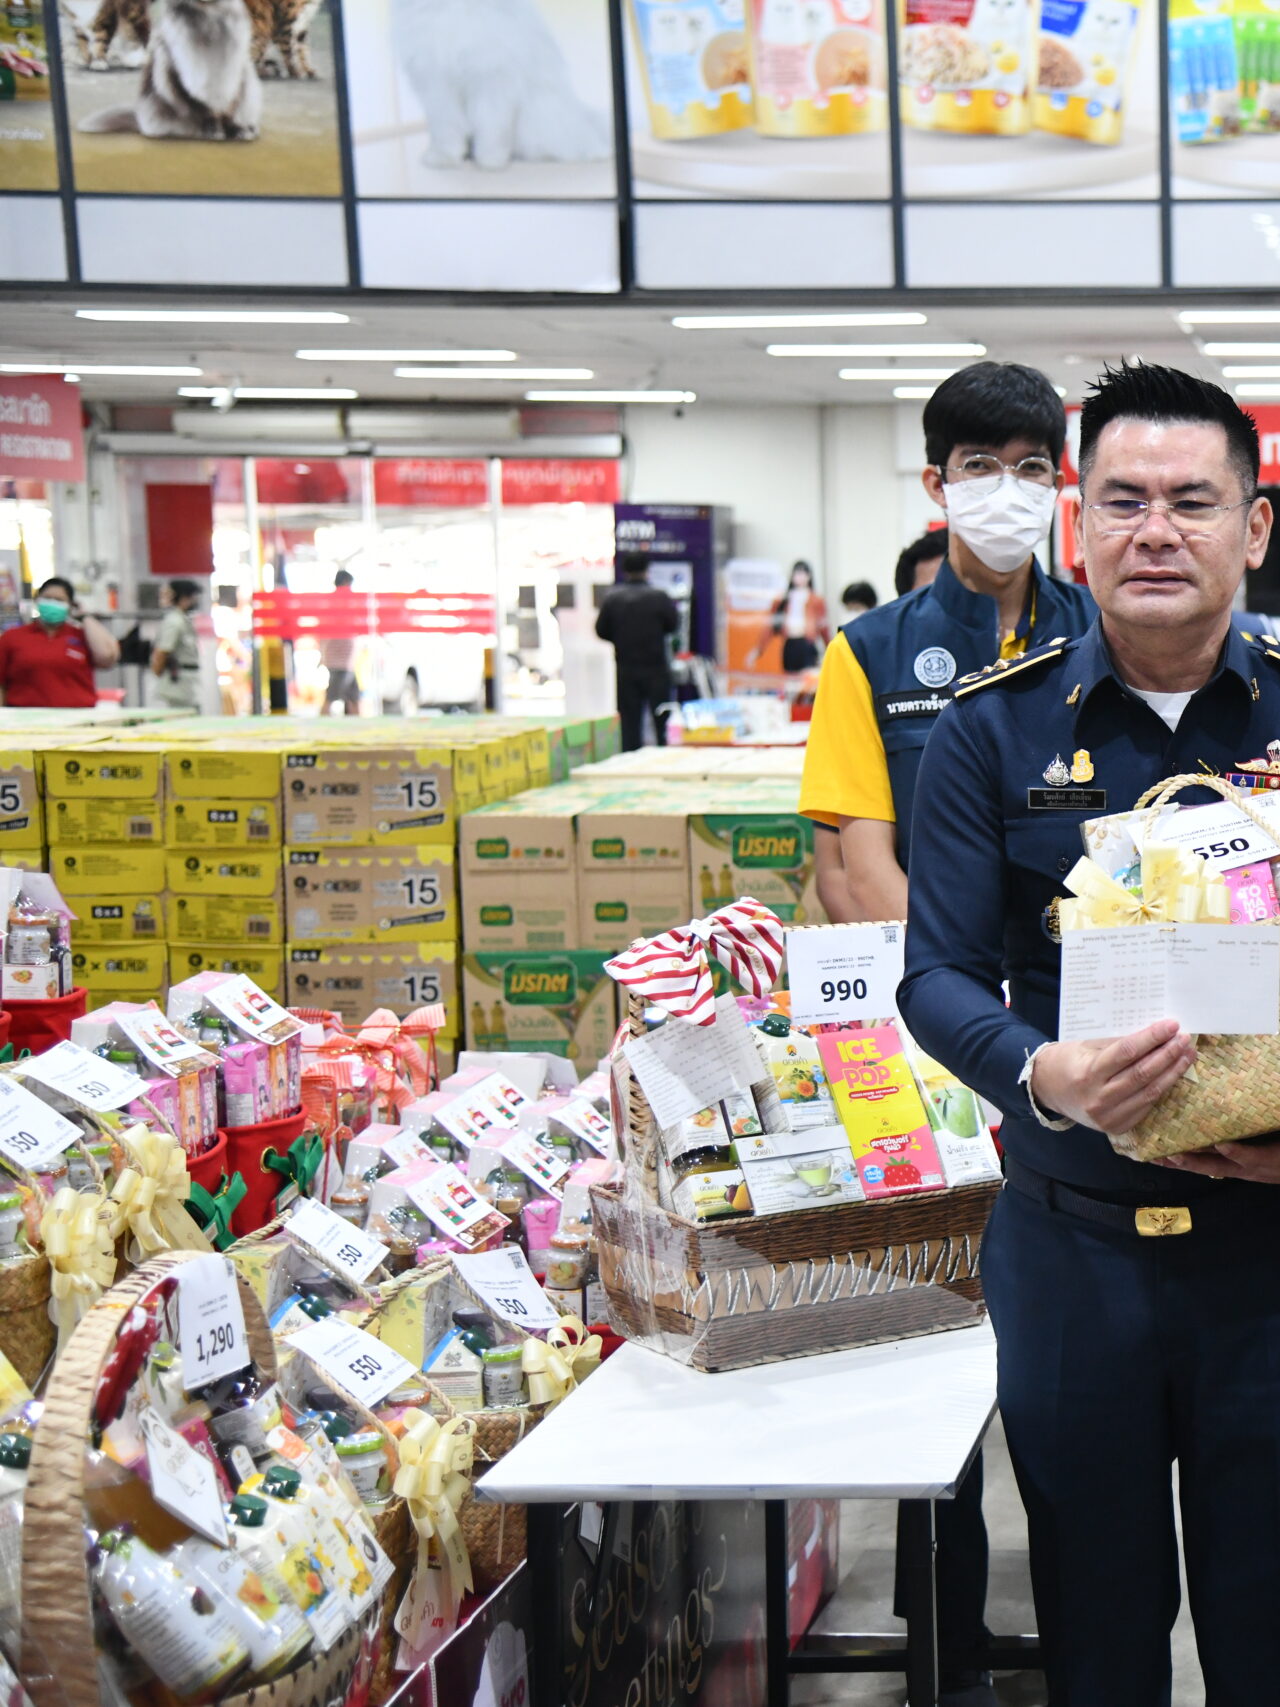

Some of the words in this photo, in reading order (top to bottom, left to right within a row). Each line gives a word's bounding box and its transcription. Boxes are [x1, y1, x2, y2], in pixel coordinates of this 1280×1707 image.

[0, 784, 20, 812] 5
[401, 780, 437, 808] 15
[1193, 837, 1250, 861] 550
[401, 878, 438, 905] 15
[403, 975, 440, 1003] 15
[820, 978, 868, 1003] 990
[836, 1037, 882, 1063] ICE
[842, 1065, 891, 1089] POP
[78, 1081, 111, 1099] 550
[5, 1131, 40, 1154] 550
[336, 1244, 363, 1267] 550
[495, 1297, 528, 1316] 550
[196, 1322, 235, 1365] 1,290
[348, 1354, 383, 1381] 550
